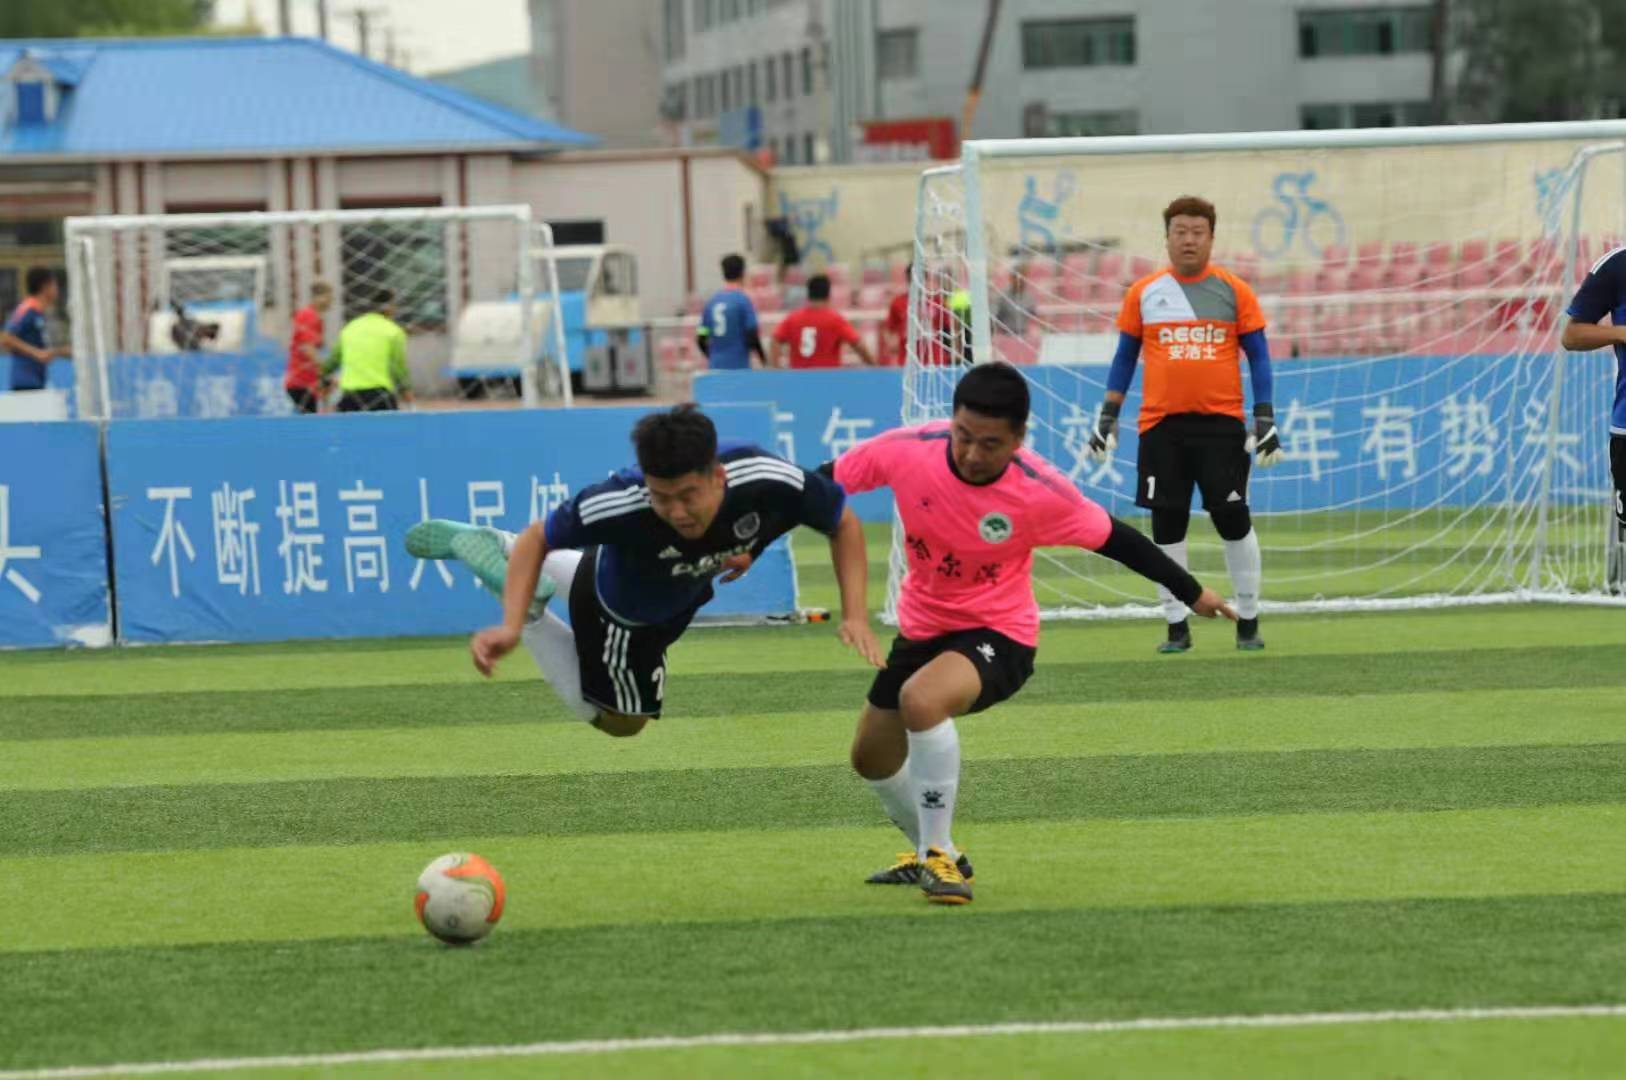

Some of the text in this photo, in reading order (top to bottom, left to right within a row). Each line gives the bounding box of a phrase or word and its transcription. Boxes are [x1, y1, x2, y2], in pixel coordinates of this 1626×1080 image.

[713, 303, 727, 337] 5
[800, 326, 817, 358] 5
[1147, 476, 1156, 500] 1
